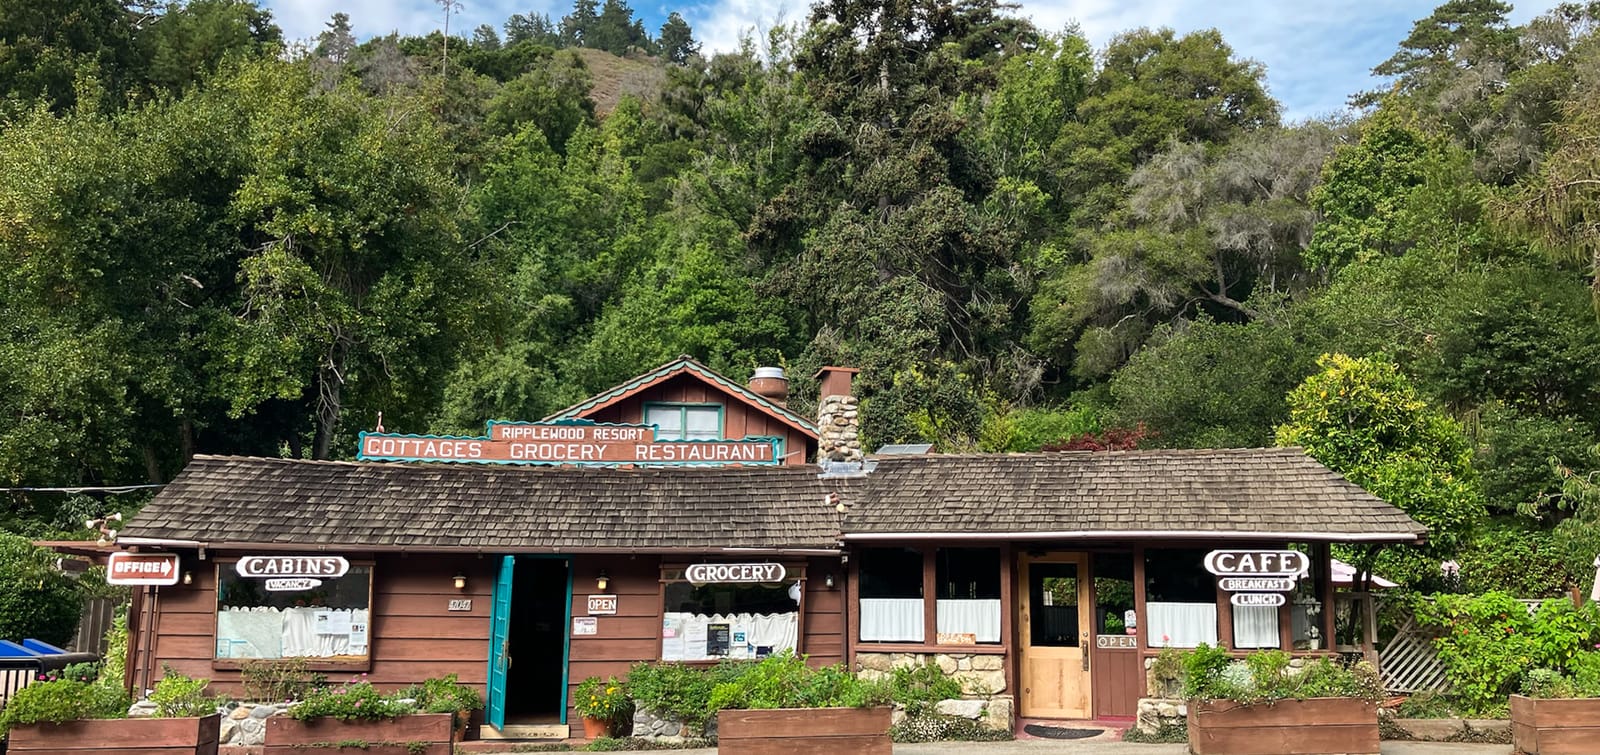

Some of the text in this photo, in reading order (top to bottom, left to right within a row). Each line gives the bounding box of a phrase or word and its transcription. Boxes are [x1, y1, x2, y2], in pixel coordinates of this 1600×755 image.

[502, 427, 645, 440] RIPPLEWOOD RESORT
[367, 439, 769, 460] COTTAGES GROCERY RESTAURANT
[115, 561, 161, 573] OFFICE
[249, 558, 337, 575] CABINS
[1216, 553, 1298, 572] CAFE
[694, 565, 776, 580] GROCERY
[1228, 579, 1285, 589] BREAKFAST
[589, 599, 617, 610] OPEN
[1241, 594, 1276, 605] LUNCH
[1098, 637, 1136, 647] OPEN
